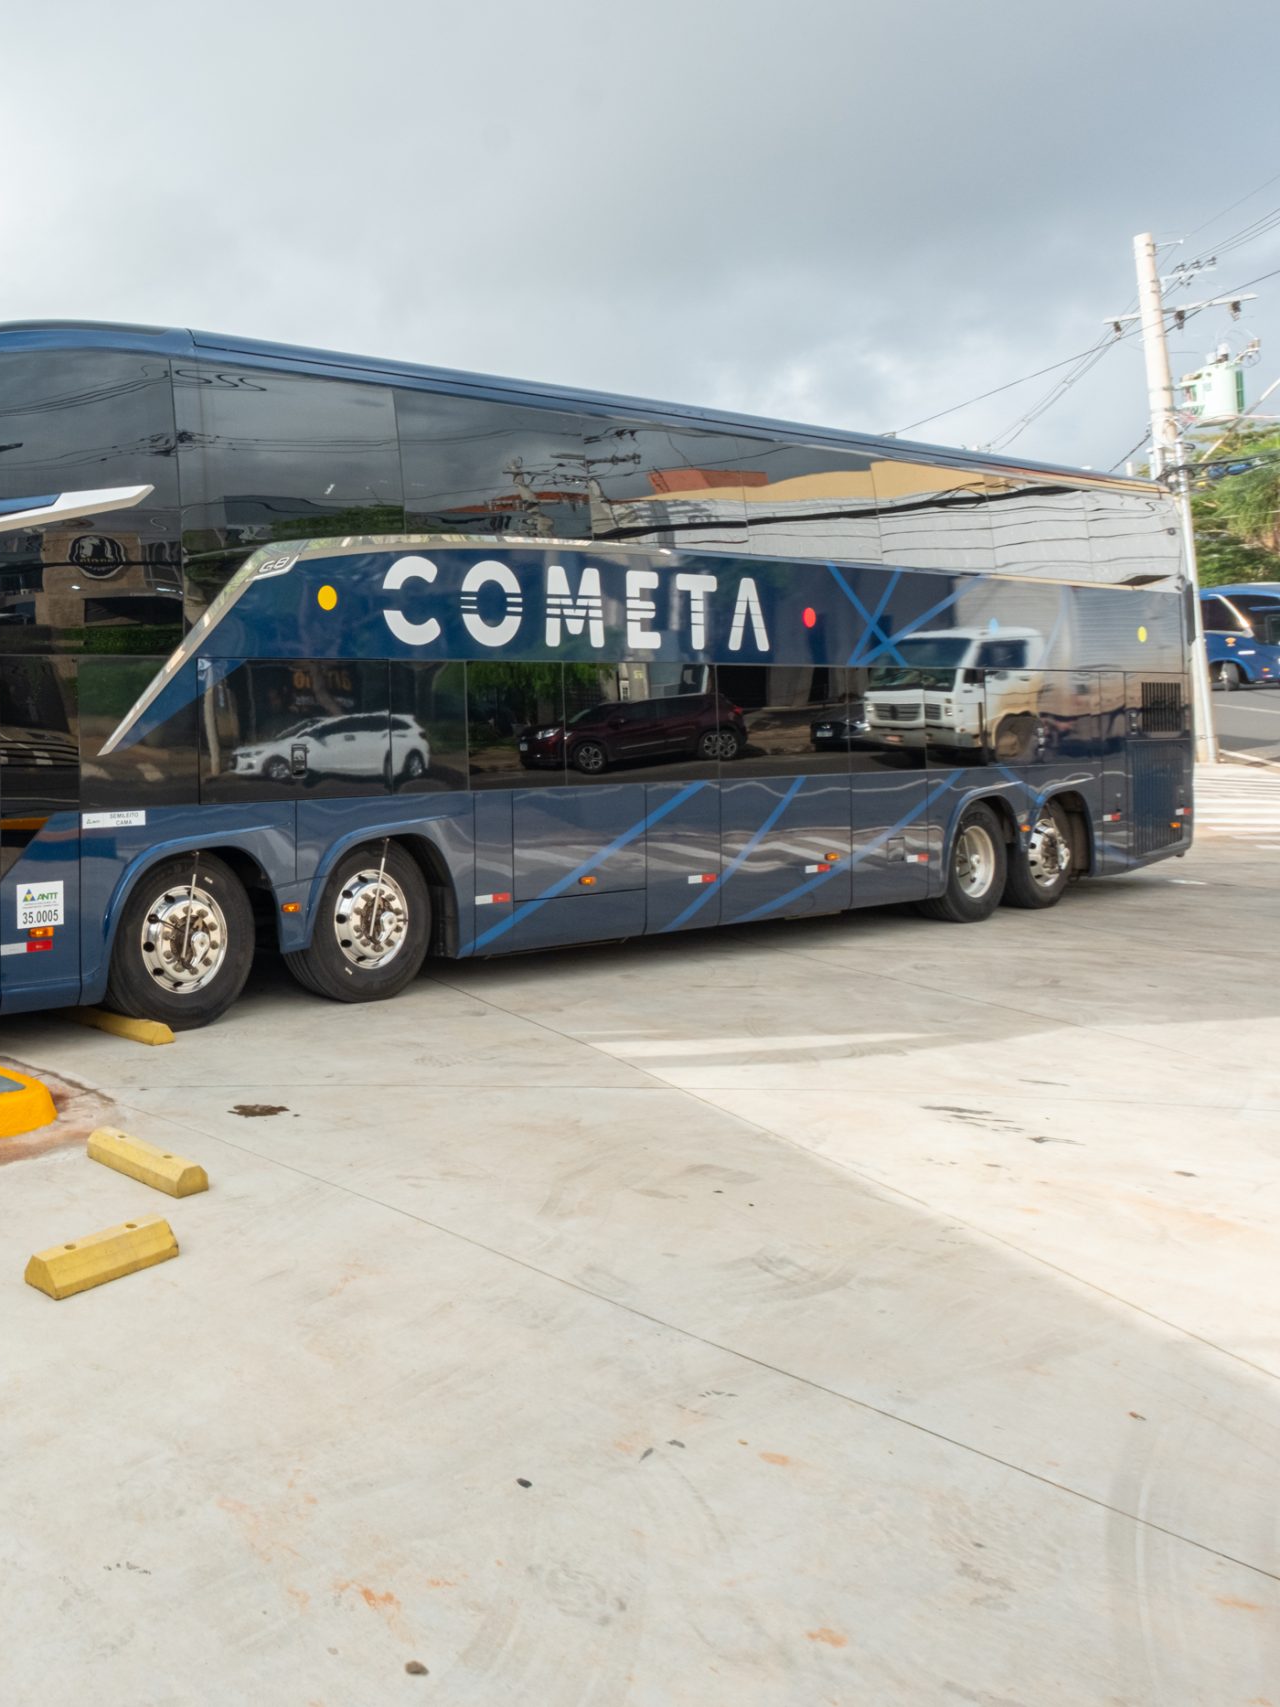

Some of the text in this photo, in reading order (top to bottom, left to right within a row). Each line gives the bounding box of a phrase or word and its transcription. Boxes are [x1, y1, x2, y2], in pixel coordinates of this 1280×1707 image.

[259, 556, 290, 573] G8
[382, 555, 770, 652] COMETA
[37, 891, 59, 901] ANTT
[22, 909, 59, 925] 35.0005
